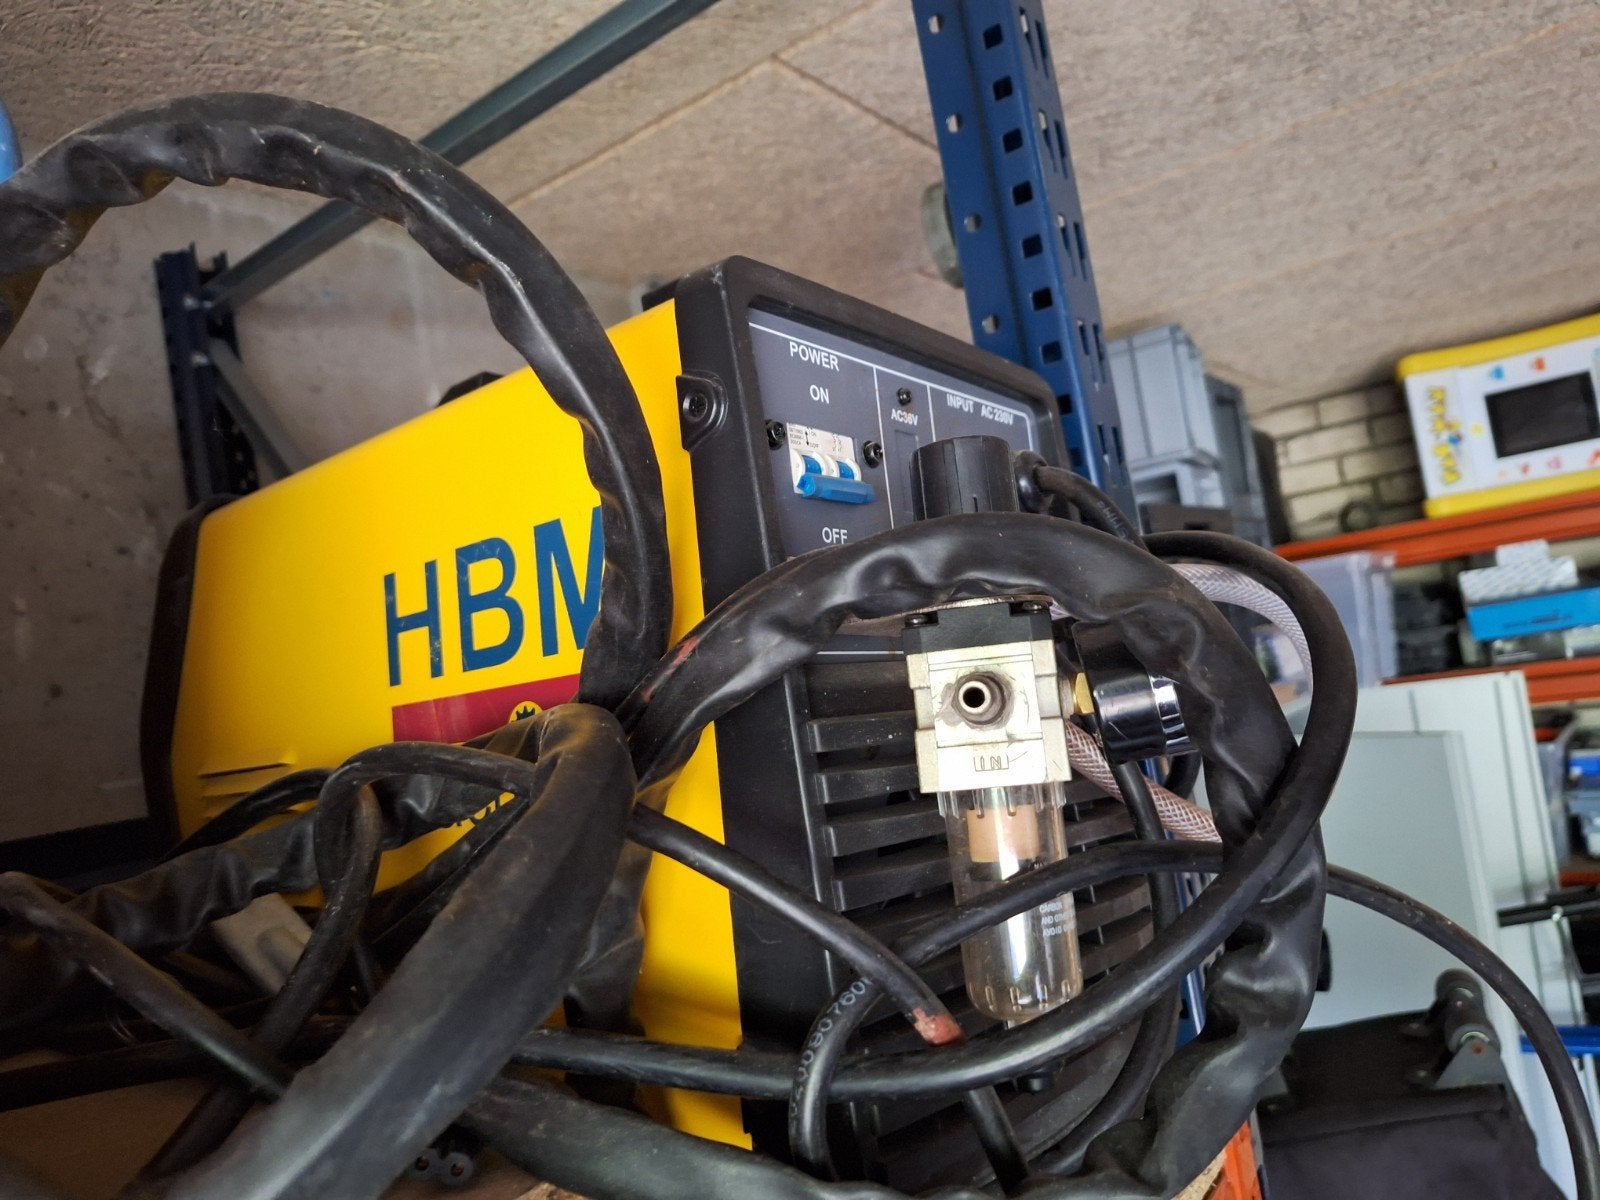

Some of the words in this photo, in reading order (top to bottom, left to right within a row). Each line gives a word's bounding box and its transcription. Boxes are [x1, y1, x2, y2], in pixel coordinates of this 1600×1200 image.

[789, 341, 840, 372] POWER
[809, 384, 830, 404] ON
[946, 392, 974, 414] INPUT
[821, 526, 848, 545] OFF
[384, 505, 606, 687] HBM
[980, 755, 1002, 770] IN
[1041, 915, 1054, 925] AND
